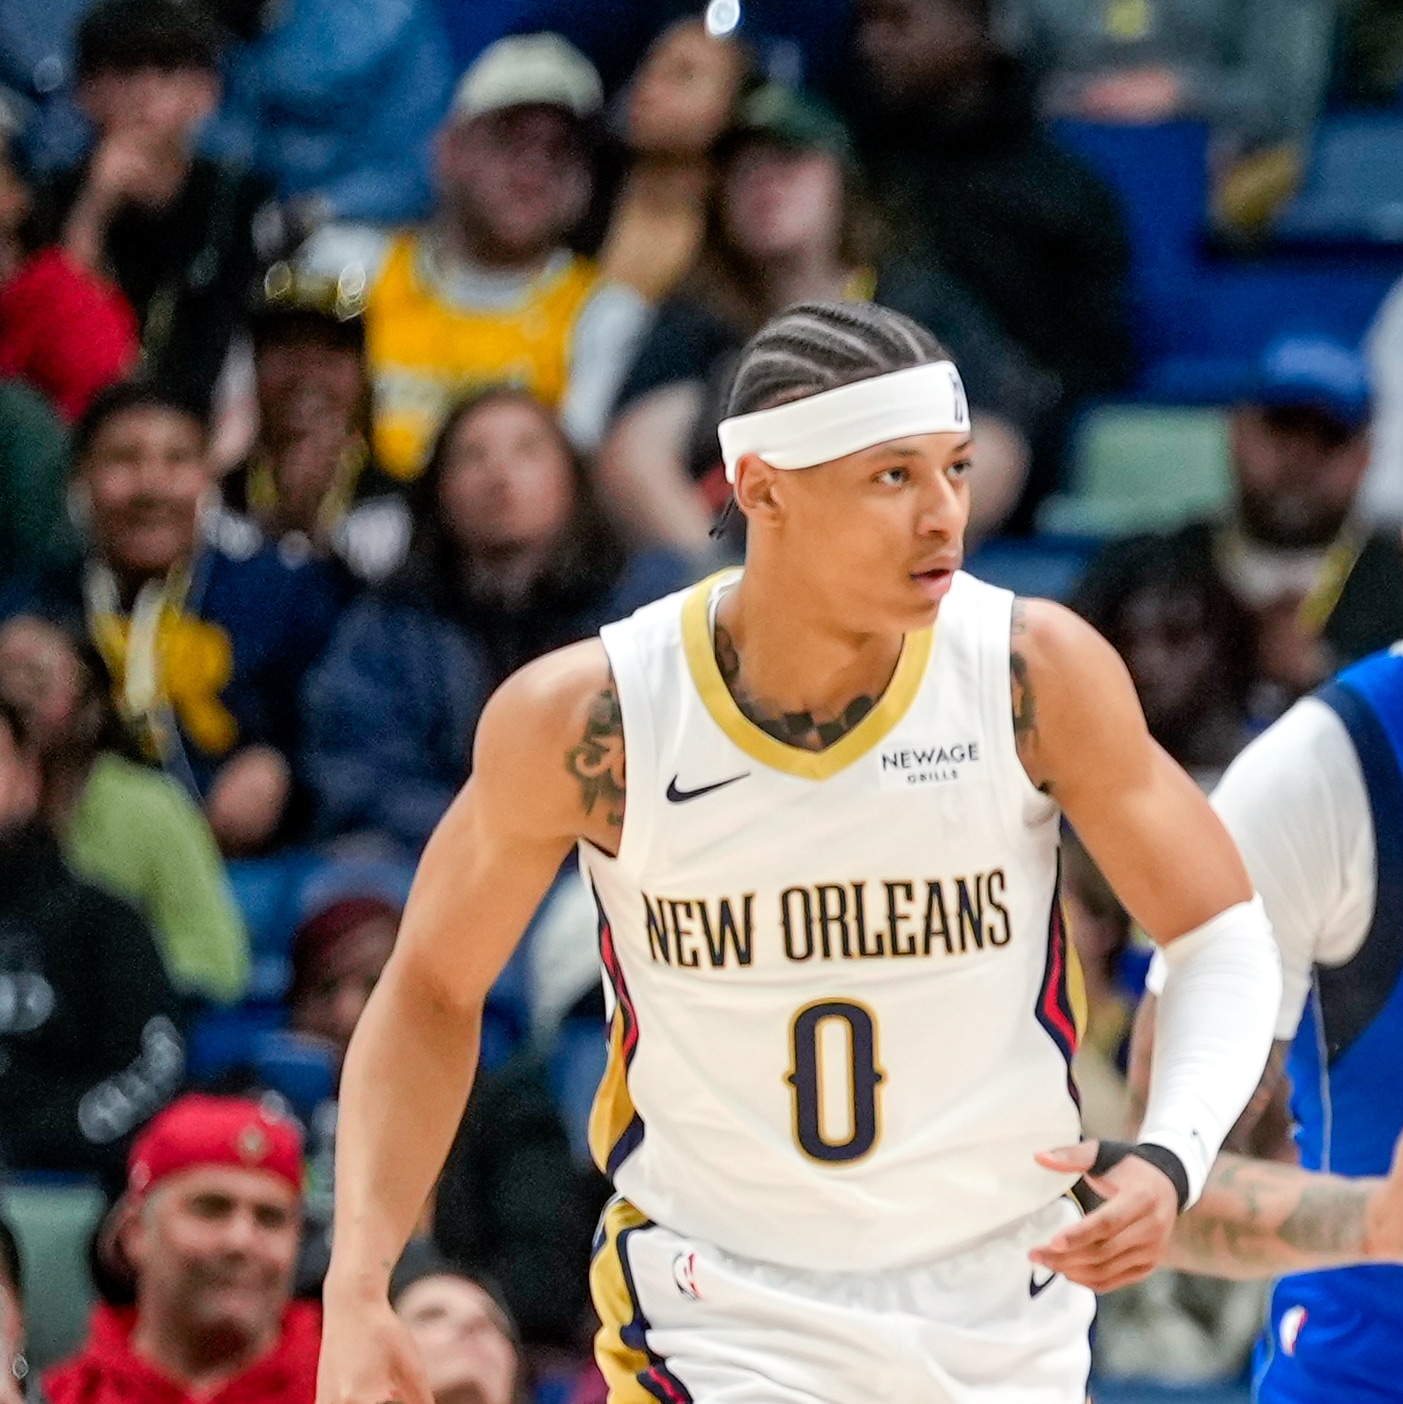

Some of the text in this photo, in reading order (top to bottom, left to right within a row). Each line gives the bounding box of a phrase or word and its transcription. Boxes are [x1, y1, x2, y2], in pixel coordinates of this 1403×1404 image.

[882, 743, 979, 771] NEWAGE
[641, 867, 1013, 969] NEW ORLEANS
[783, 996, 889, 1170] 0
